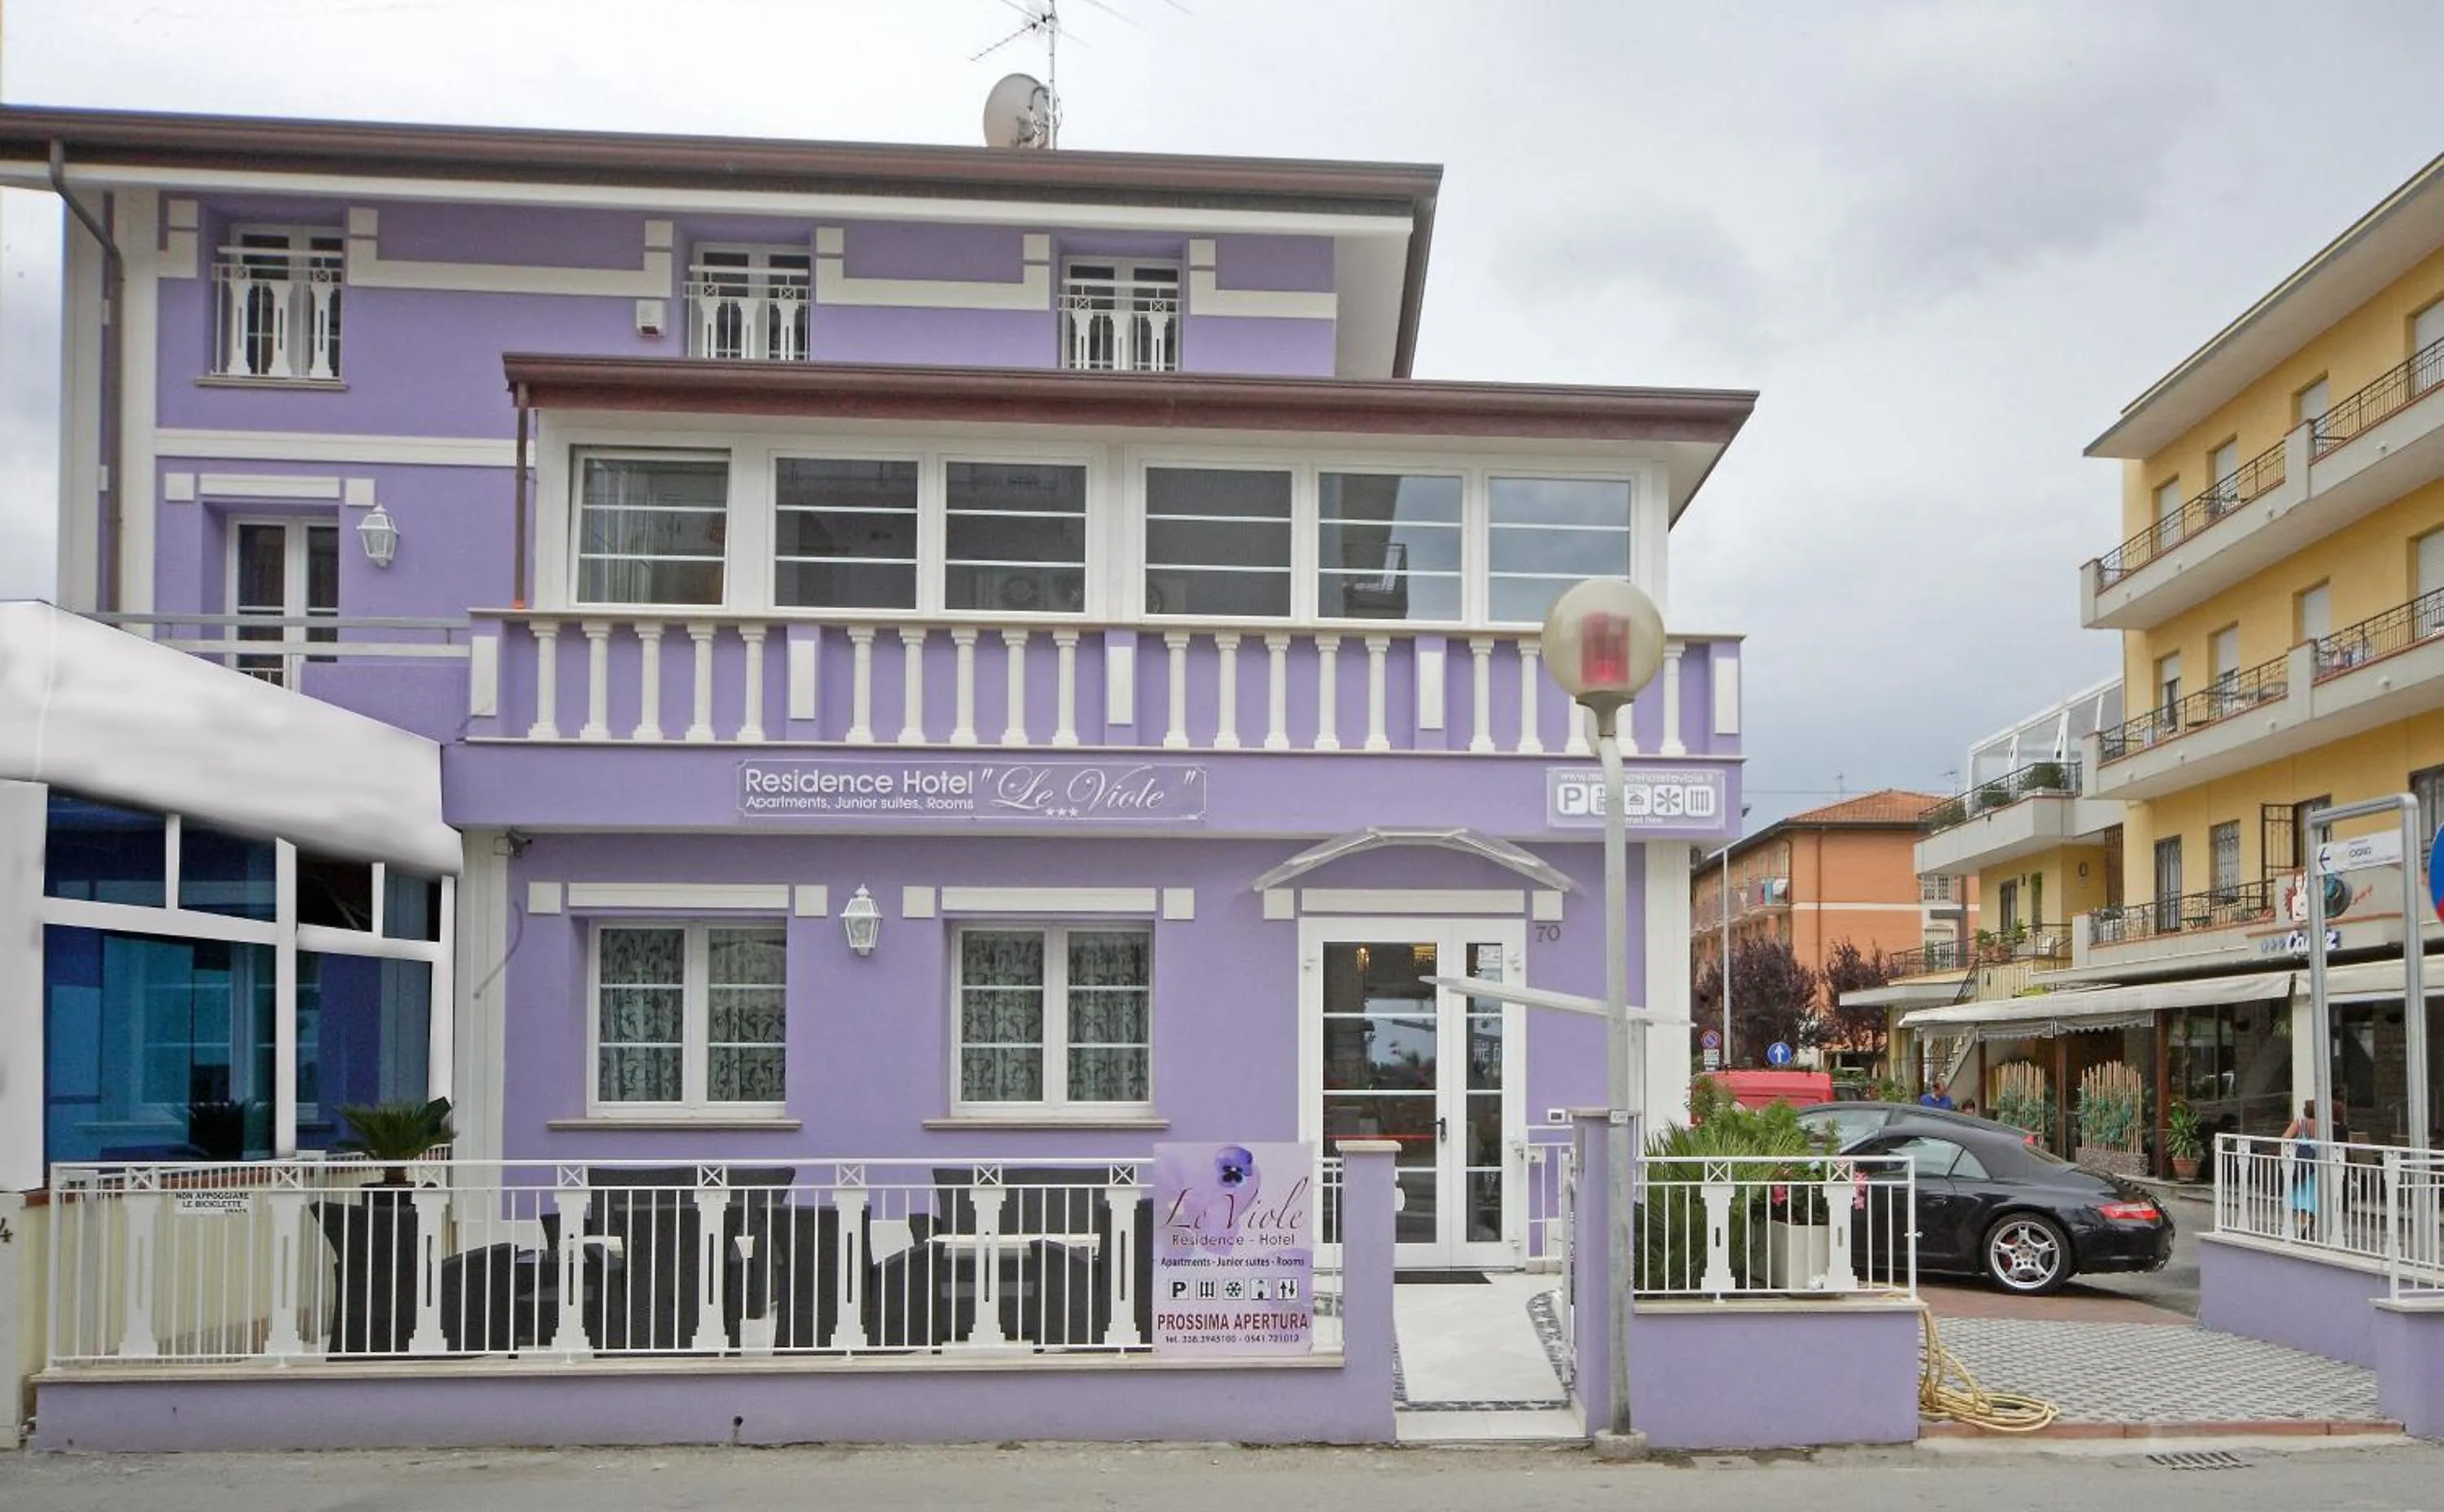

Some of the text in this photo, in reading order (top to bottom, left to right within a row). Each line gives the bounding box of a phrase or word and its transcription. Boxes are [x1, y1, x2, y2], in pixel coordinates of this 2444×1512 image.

[745, 768, 894, 793] Residence
[903, 770, 974, 795] Hotel
[835, 796, 877, 810] Junior
[927, 797, 974, 810] Rooms
[1536, 925, 1561, 943] 70
[175, 1192, 249, 1200] NON APPOGGIARE
[1167, 1176, 1308, 1229] Le Viole
[1172, 1234, 1244, 1246] Residence
[1259, 1234, 1295, 1246] Hotel
[1161, 1256, 1211, 1268] Apartments
[1216, 1257, 1244, 1267] Junior
[1246, 1257, 1270, 1267] suites
[1277, 1256, 1305, 1267] Rooms
[1158, 1313, 1308, 1330] PROSSIMA APERTURA
